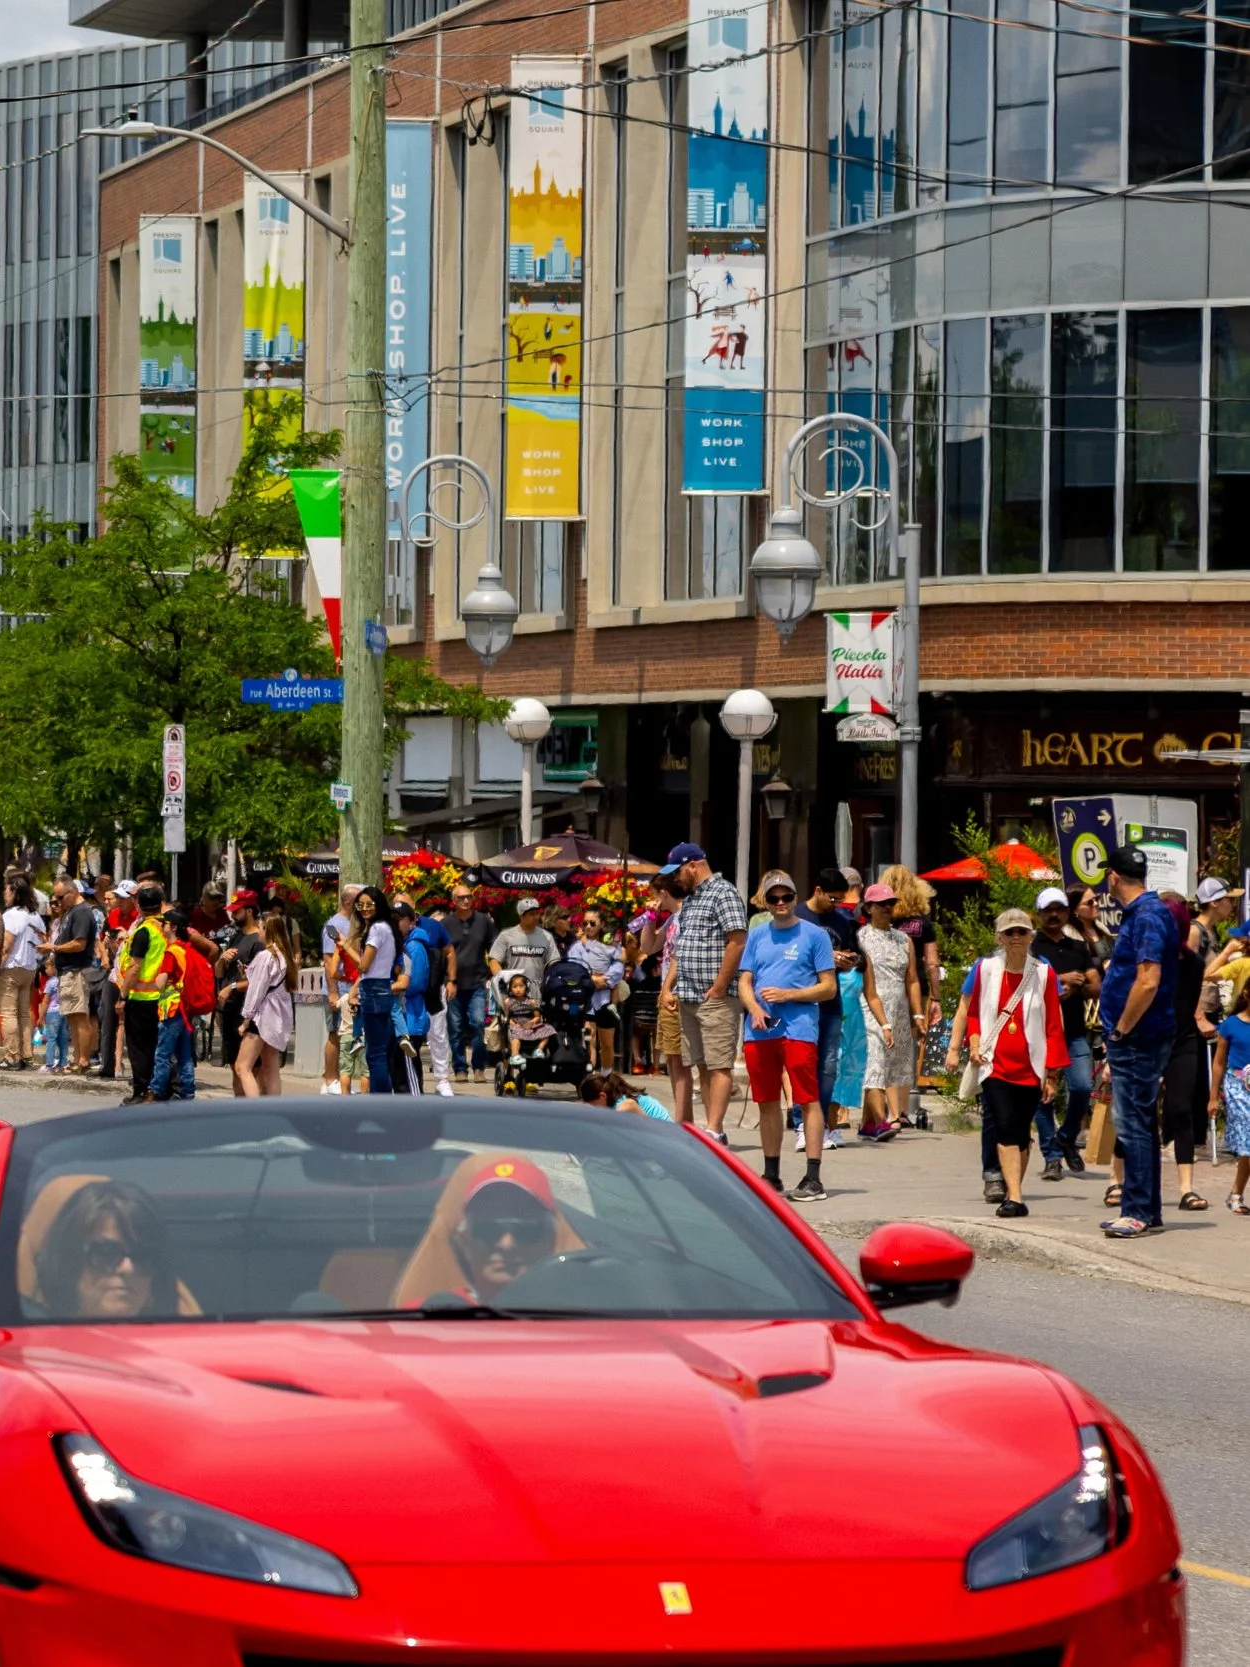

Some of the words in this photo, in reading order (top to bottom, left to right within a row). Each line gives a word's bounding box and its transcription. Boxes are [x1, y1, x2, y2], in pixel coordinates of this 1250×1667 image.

[390, 170, 407, 256] LIVE.
[701, 418, 748, 427] WORK.
[701, 437, 746, 447] SHOP.
[703, 456, 743, 467] LIVE.
[832, 648, 888, 661] Piccola
[835, 664, 885, 679] Italia
[250, 689, 262, 698] rue
[266, 681, 321, 698] Aberdeen
[1083, 847, 1096, 871] P
[306, 862, 340, 874] GUINNES
[501, 871, 557, 884] GUINNESS
